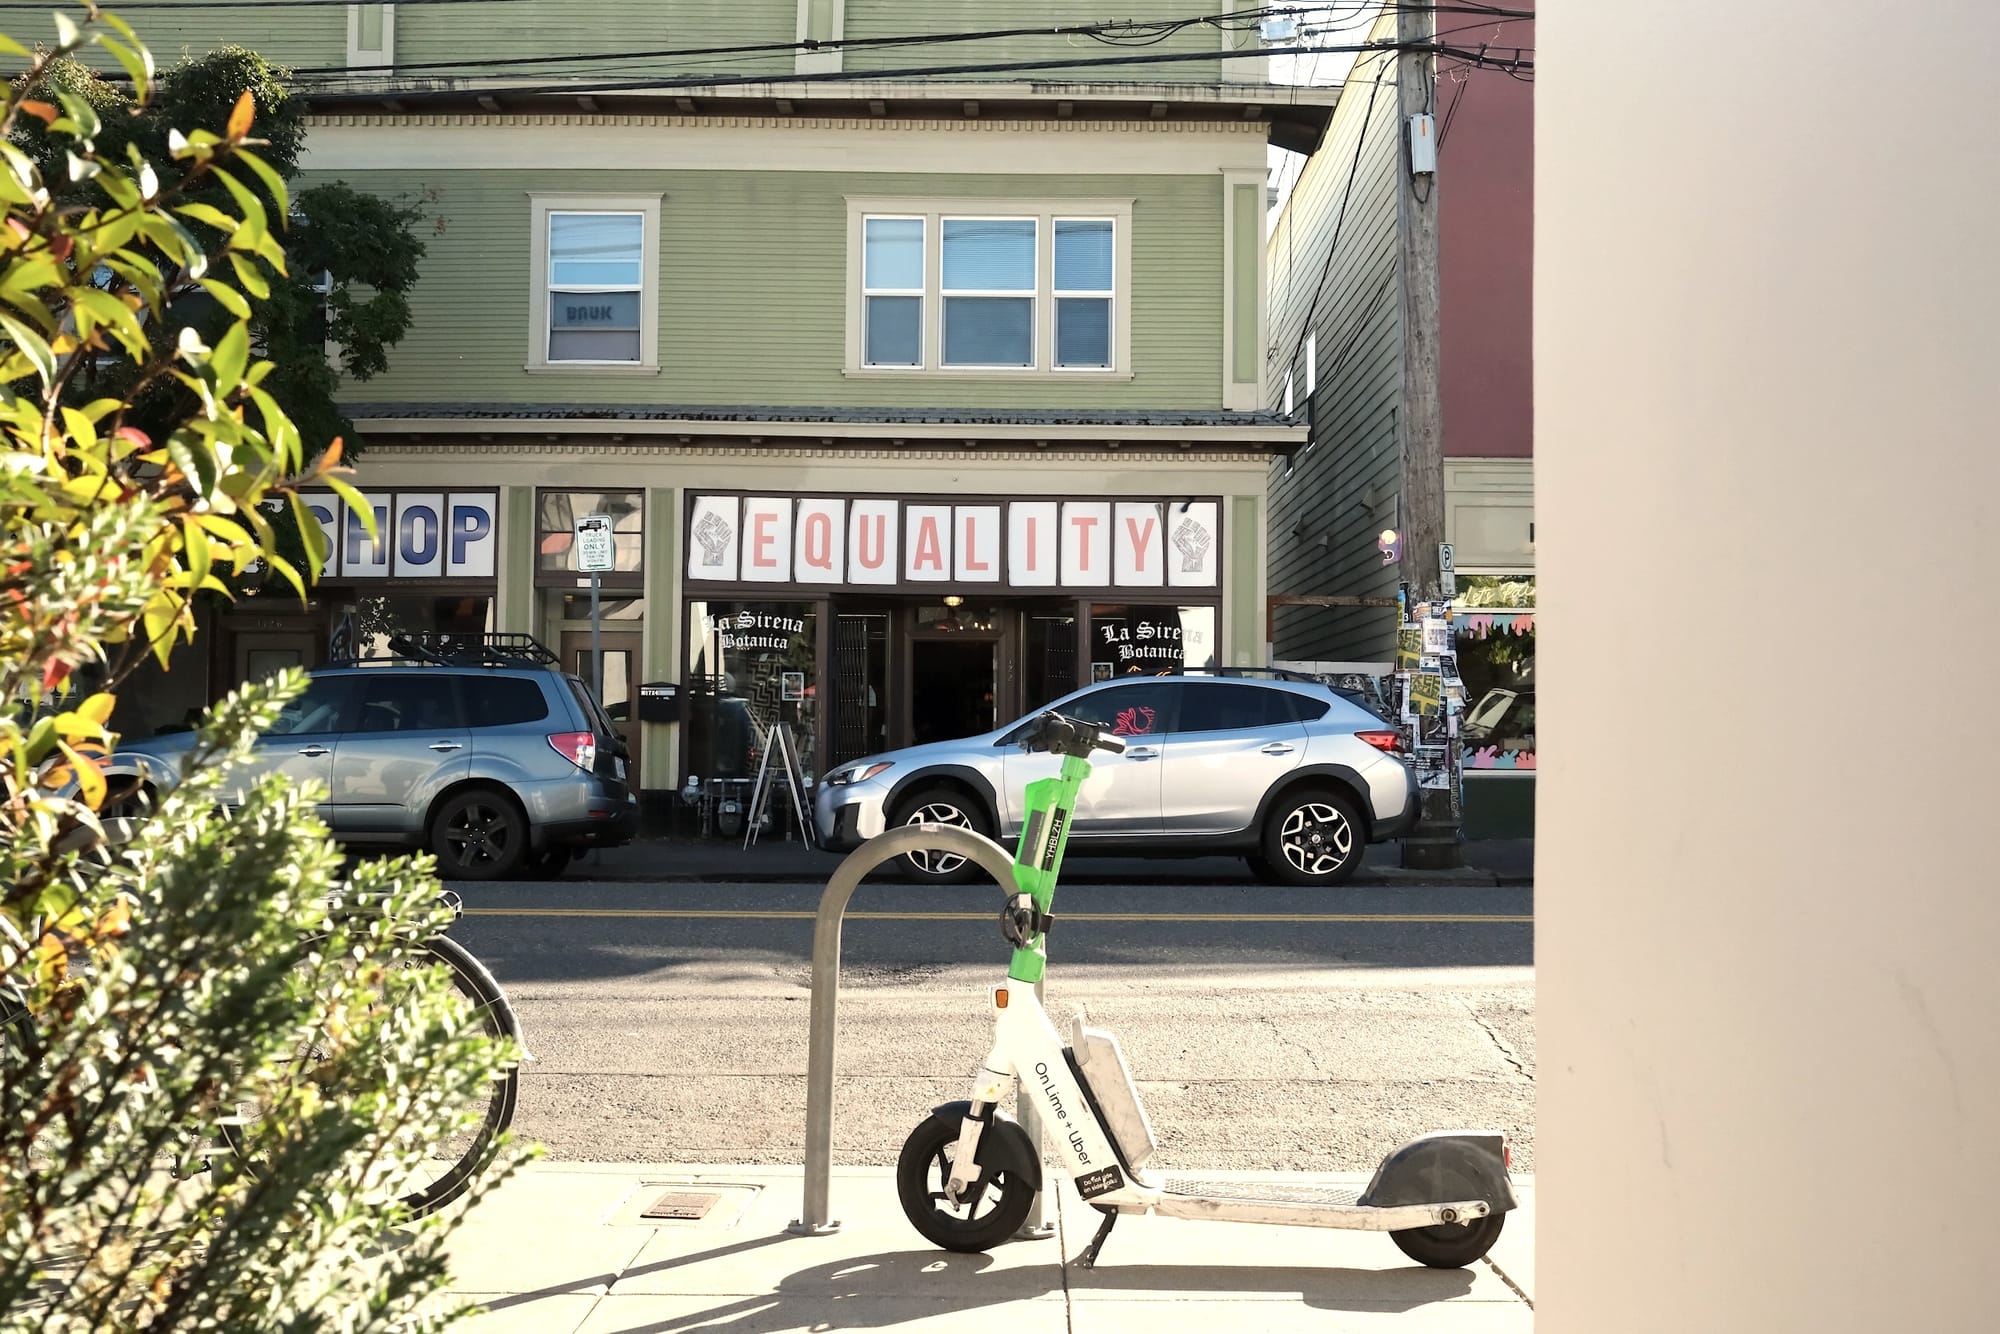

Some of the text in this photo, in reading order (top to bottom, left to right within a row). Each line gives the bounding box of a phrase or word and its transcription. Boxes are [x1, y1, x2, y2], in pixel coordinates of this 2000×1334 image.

[753, 512, 1155, 572] EQUALITY
[702, 611, 804, 633] La Sirena
[1101, 621, 1203, 644] La Sirena
[719, 633, 788, 649] Botanica
[1118, 644, 1186, 662] Botanica
[1045, 819, 1063, 858] YHBLZH
[1035, 1062, 1050, 1085] On
[1044, 1084, 1067, 1119] Lime
[1068, 1130, 1091, 1165] Uber
